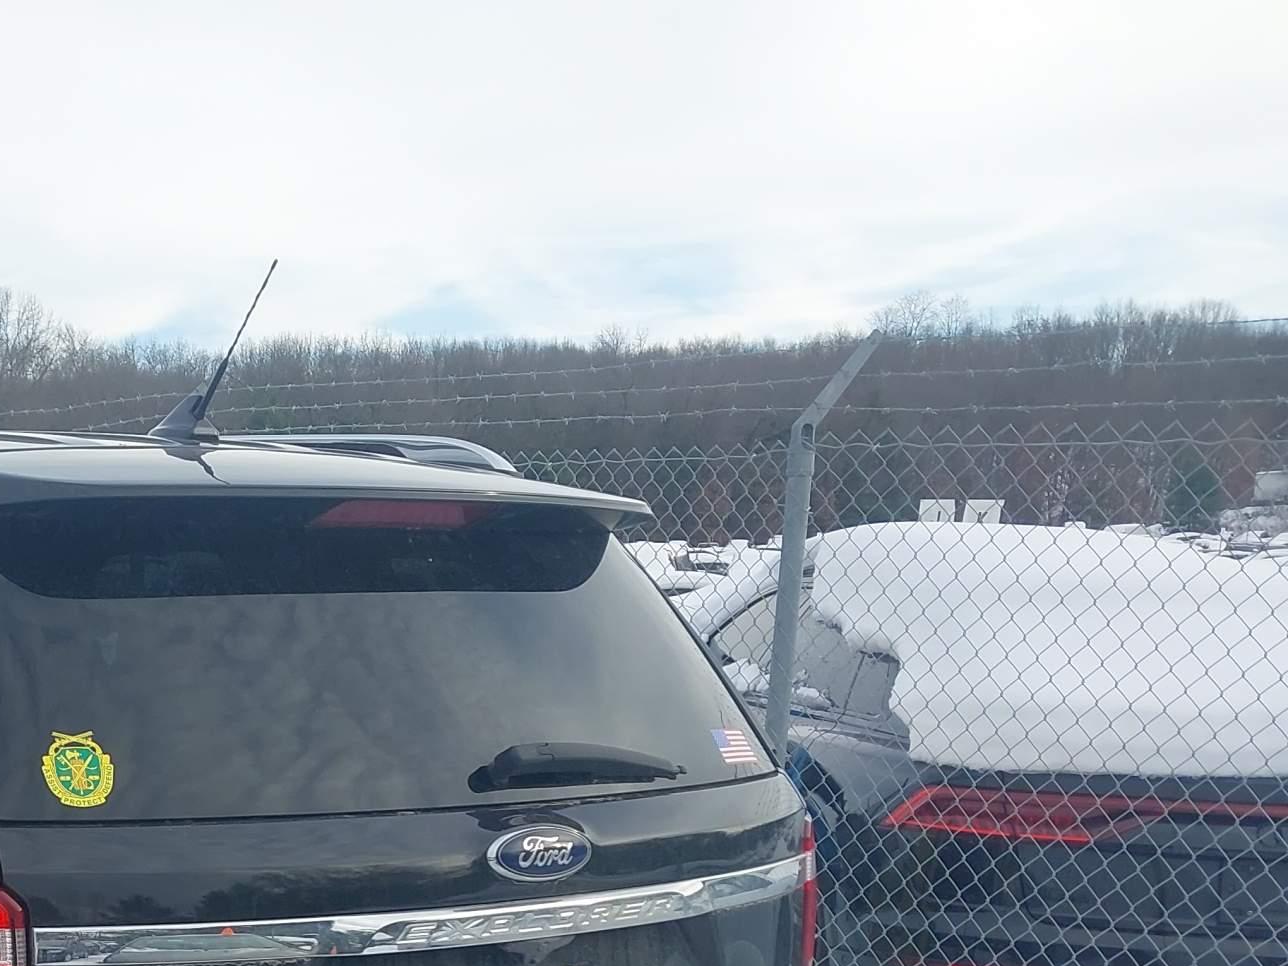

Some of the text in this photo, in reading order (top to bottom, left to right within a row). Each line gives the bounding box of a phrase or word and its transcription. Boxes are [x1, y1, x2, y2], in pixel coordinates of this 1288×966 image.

[44, 766, 63, 796] ASSIST
[103, 764, 113, 794] DEFEND
[63, 796, 103, 807] PROTECT
[518, 836, 573, 868] Ford
[396, 897, 673, 947] EXPLORER
